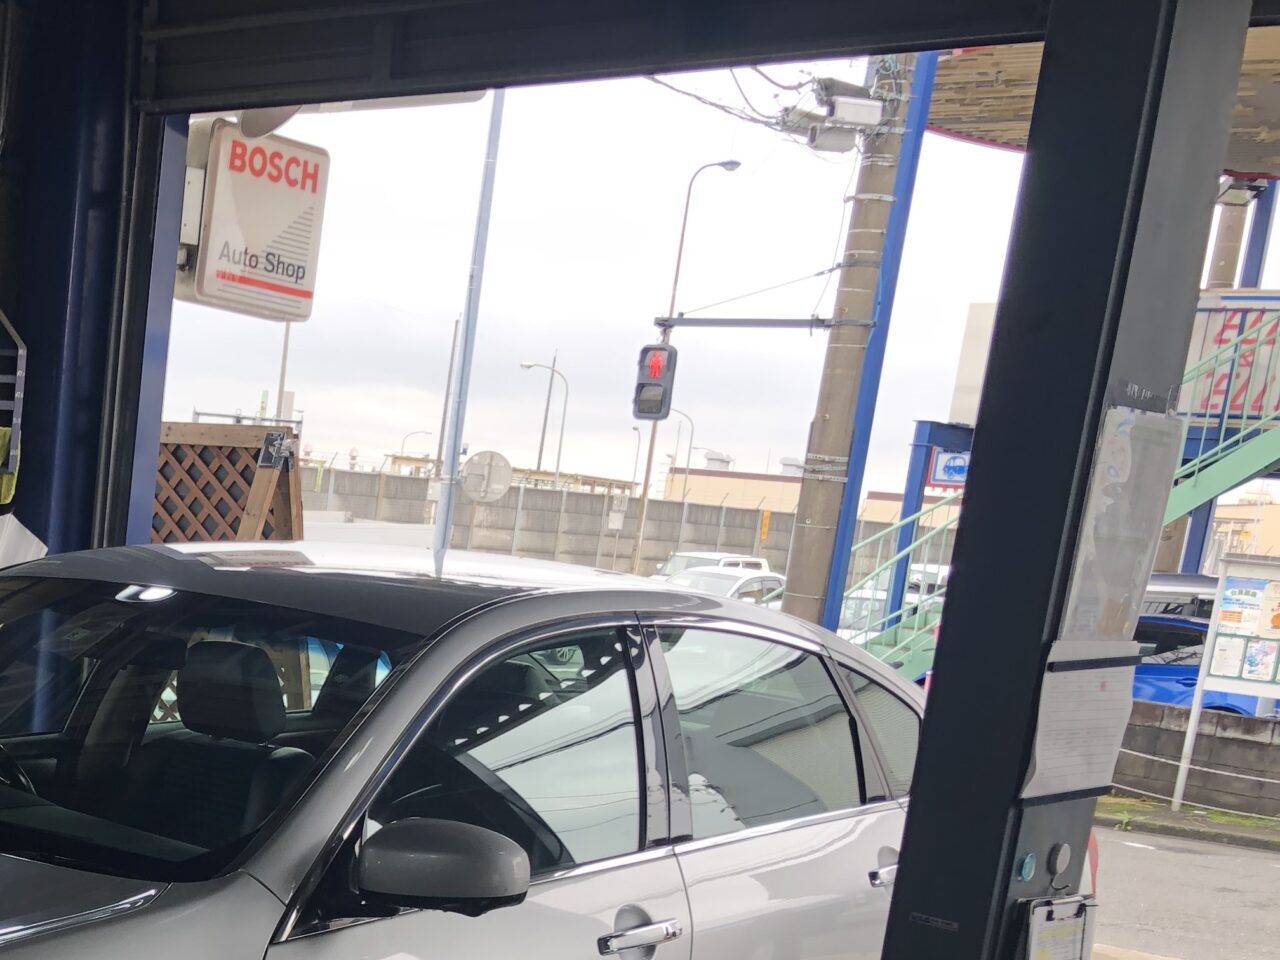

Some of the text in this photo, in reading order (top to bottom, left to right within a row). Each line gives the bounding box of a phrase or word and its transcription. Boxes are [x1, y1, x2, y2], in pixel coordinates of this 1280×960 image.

[229, 140, 320, 193] BOSCH
[219, 240, 306, 284] Auto Shop
